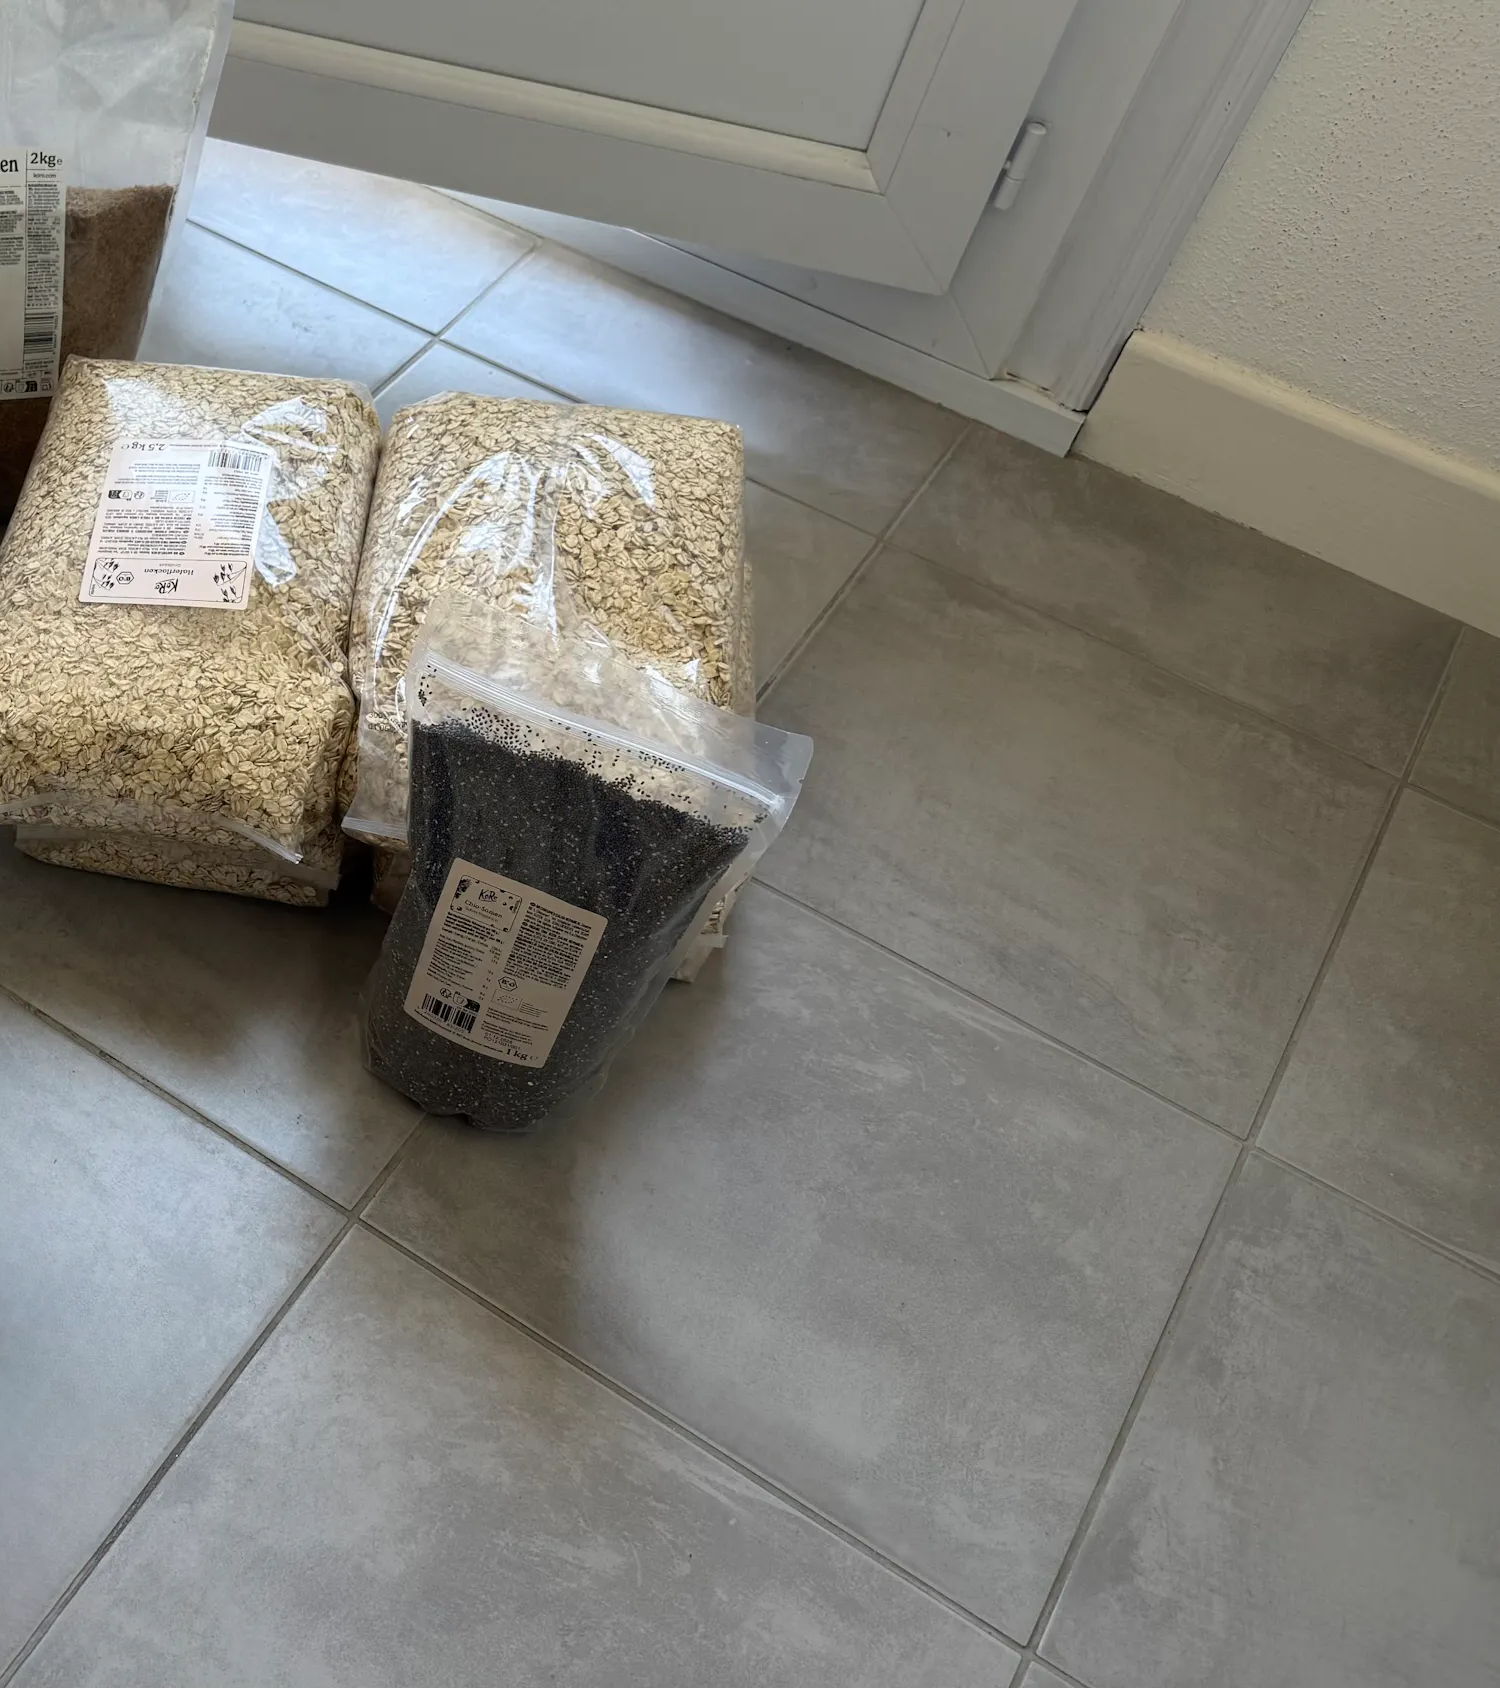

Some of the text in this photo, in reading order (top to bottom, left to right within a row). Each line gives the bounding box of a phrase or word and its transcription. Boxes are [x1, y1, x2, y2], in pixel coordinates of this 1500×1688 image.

[30, 152, 57, 168] 2kg
[132, 441, 148, 451] kg
[148, 442, 166, 452] 2,5
[144, 567, 195, 577] Haferflocken
[154, 578, 179, 595] KoRo
[478, 888, 499, 904] KoRo
[513, 1049, 529, 1061] kg
